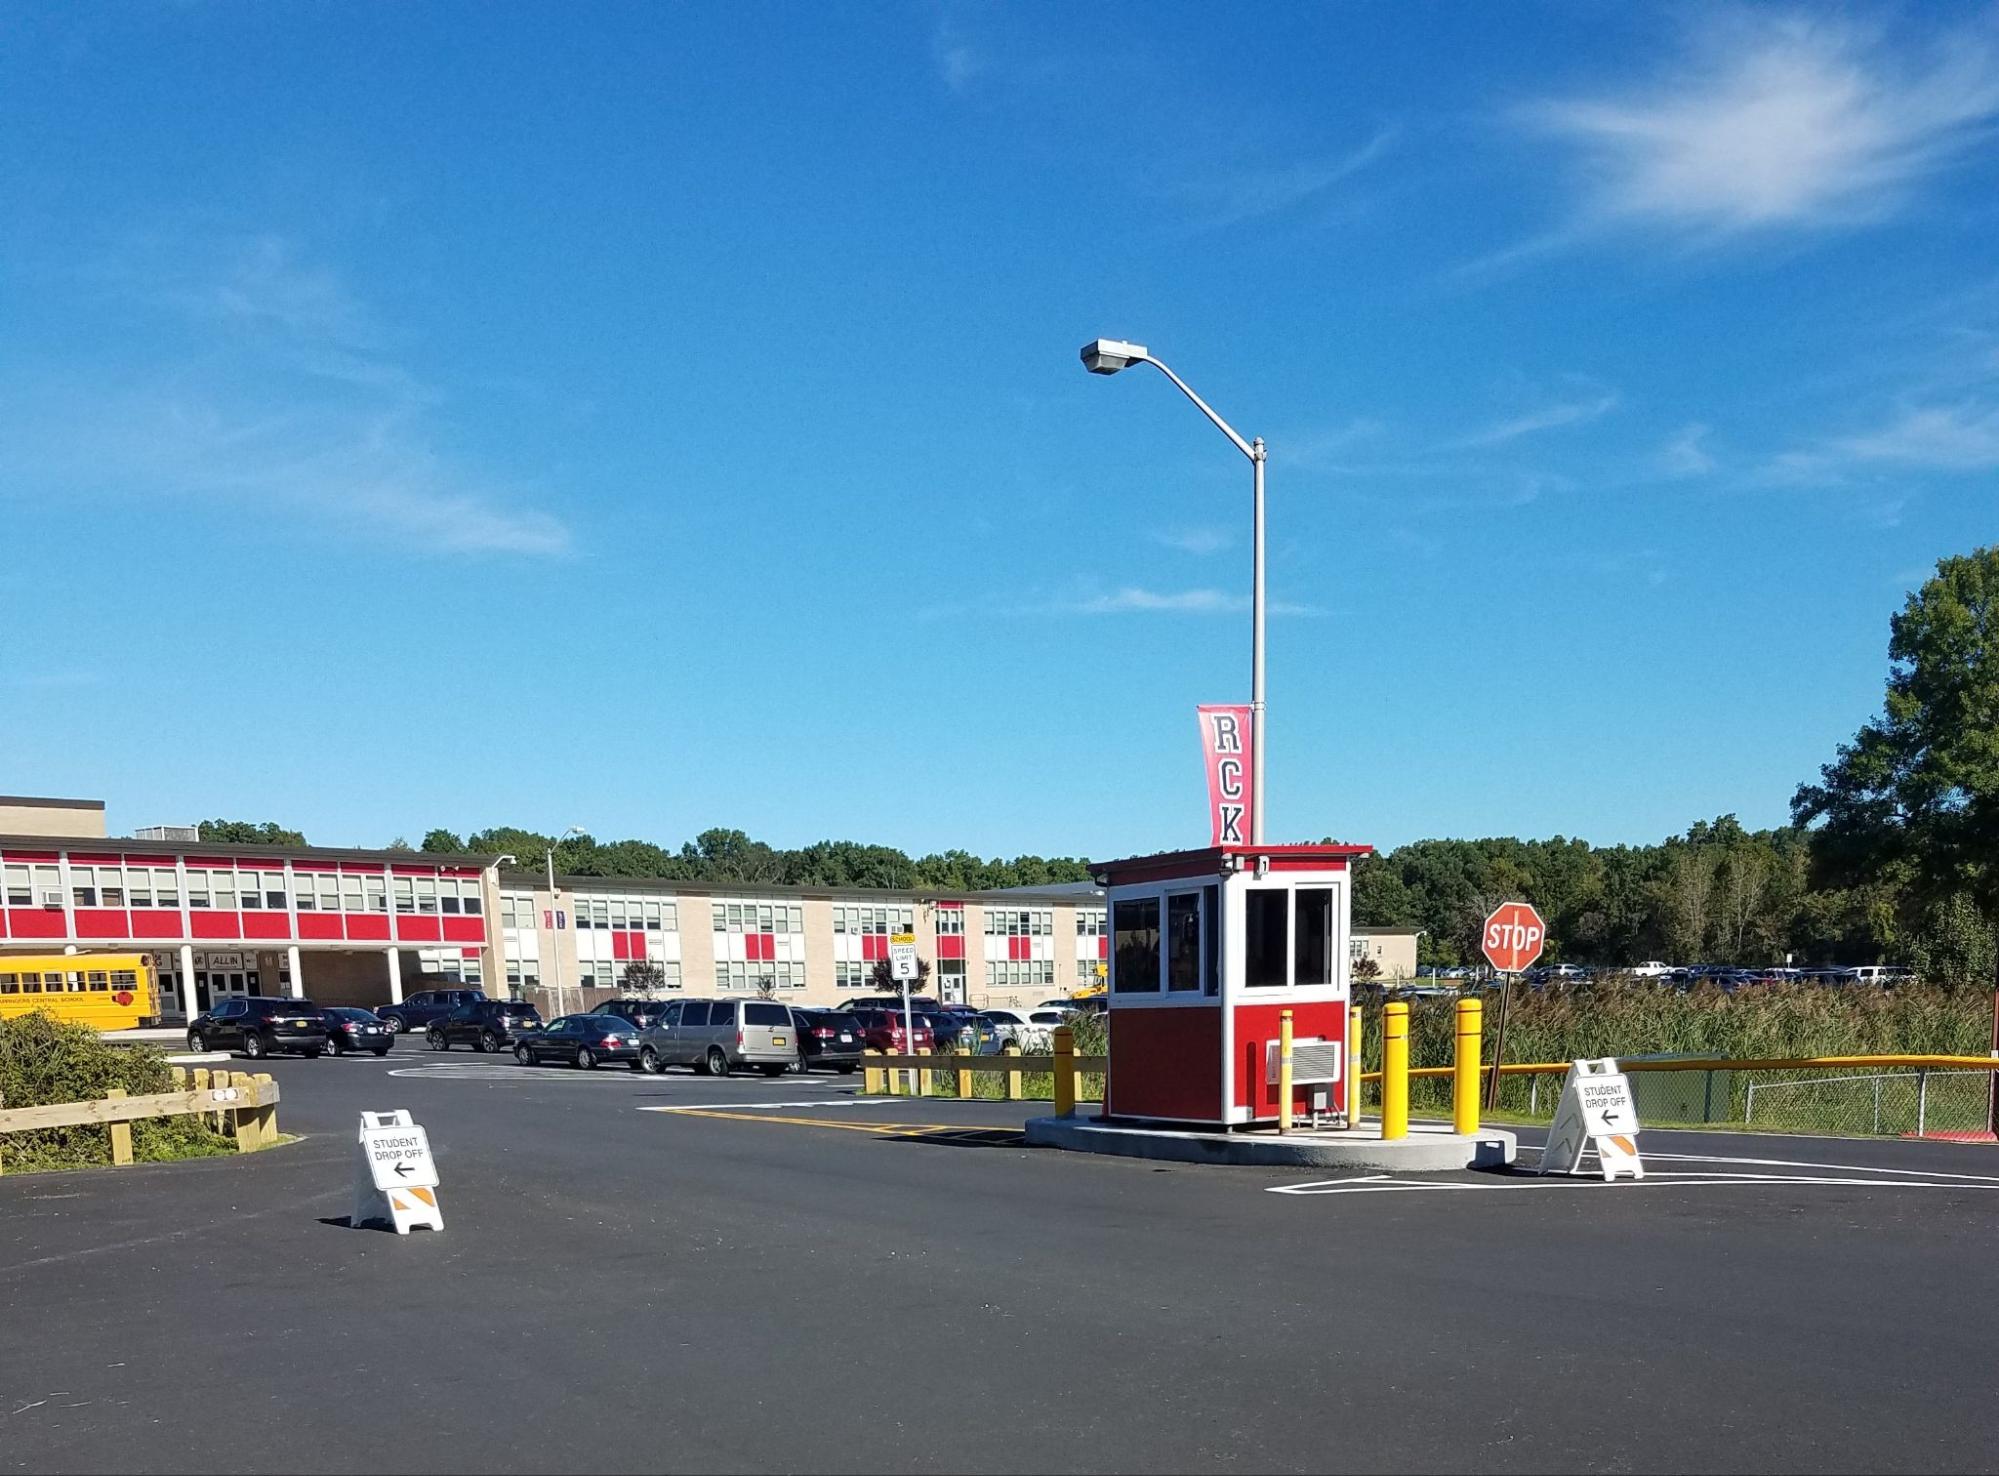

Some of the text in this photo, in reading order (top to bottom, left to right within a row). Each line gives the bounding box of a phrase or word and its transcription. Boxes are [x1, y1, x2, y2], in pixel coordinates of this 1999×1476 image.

[1213, 715, 1243, 843] RCK
[1487, 923, 1540, 952] STOP
[900, 963, 910, 975] 5
[1584, 1085, 1622, 1096] STUDENT
[1585, 1096, 1626, 1108] DROP OFF
[373, 1137, 418, 1149] STUDENT
[375, 1149, 423, 1161] DROP OFF
